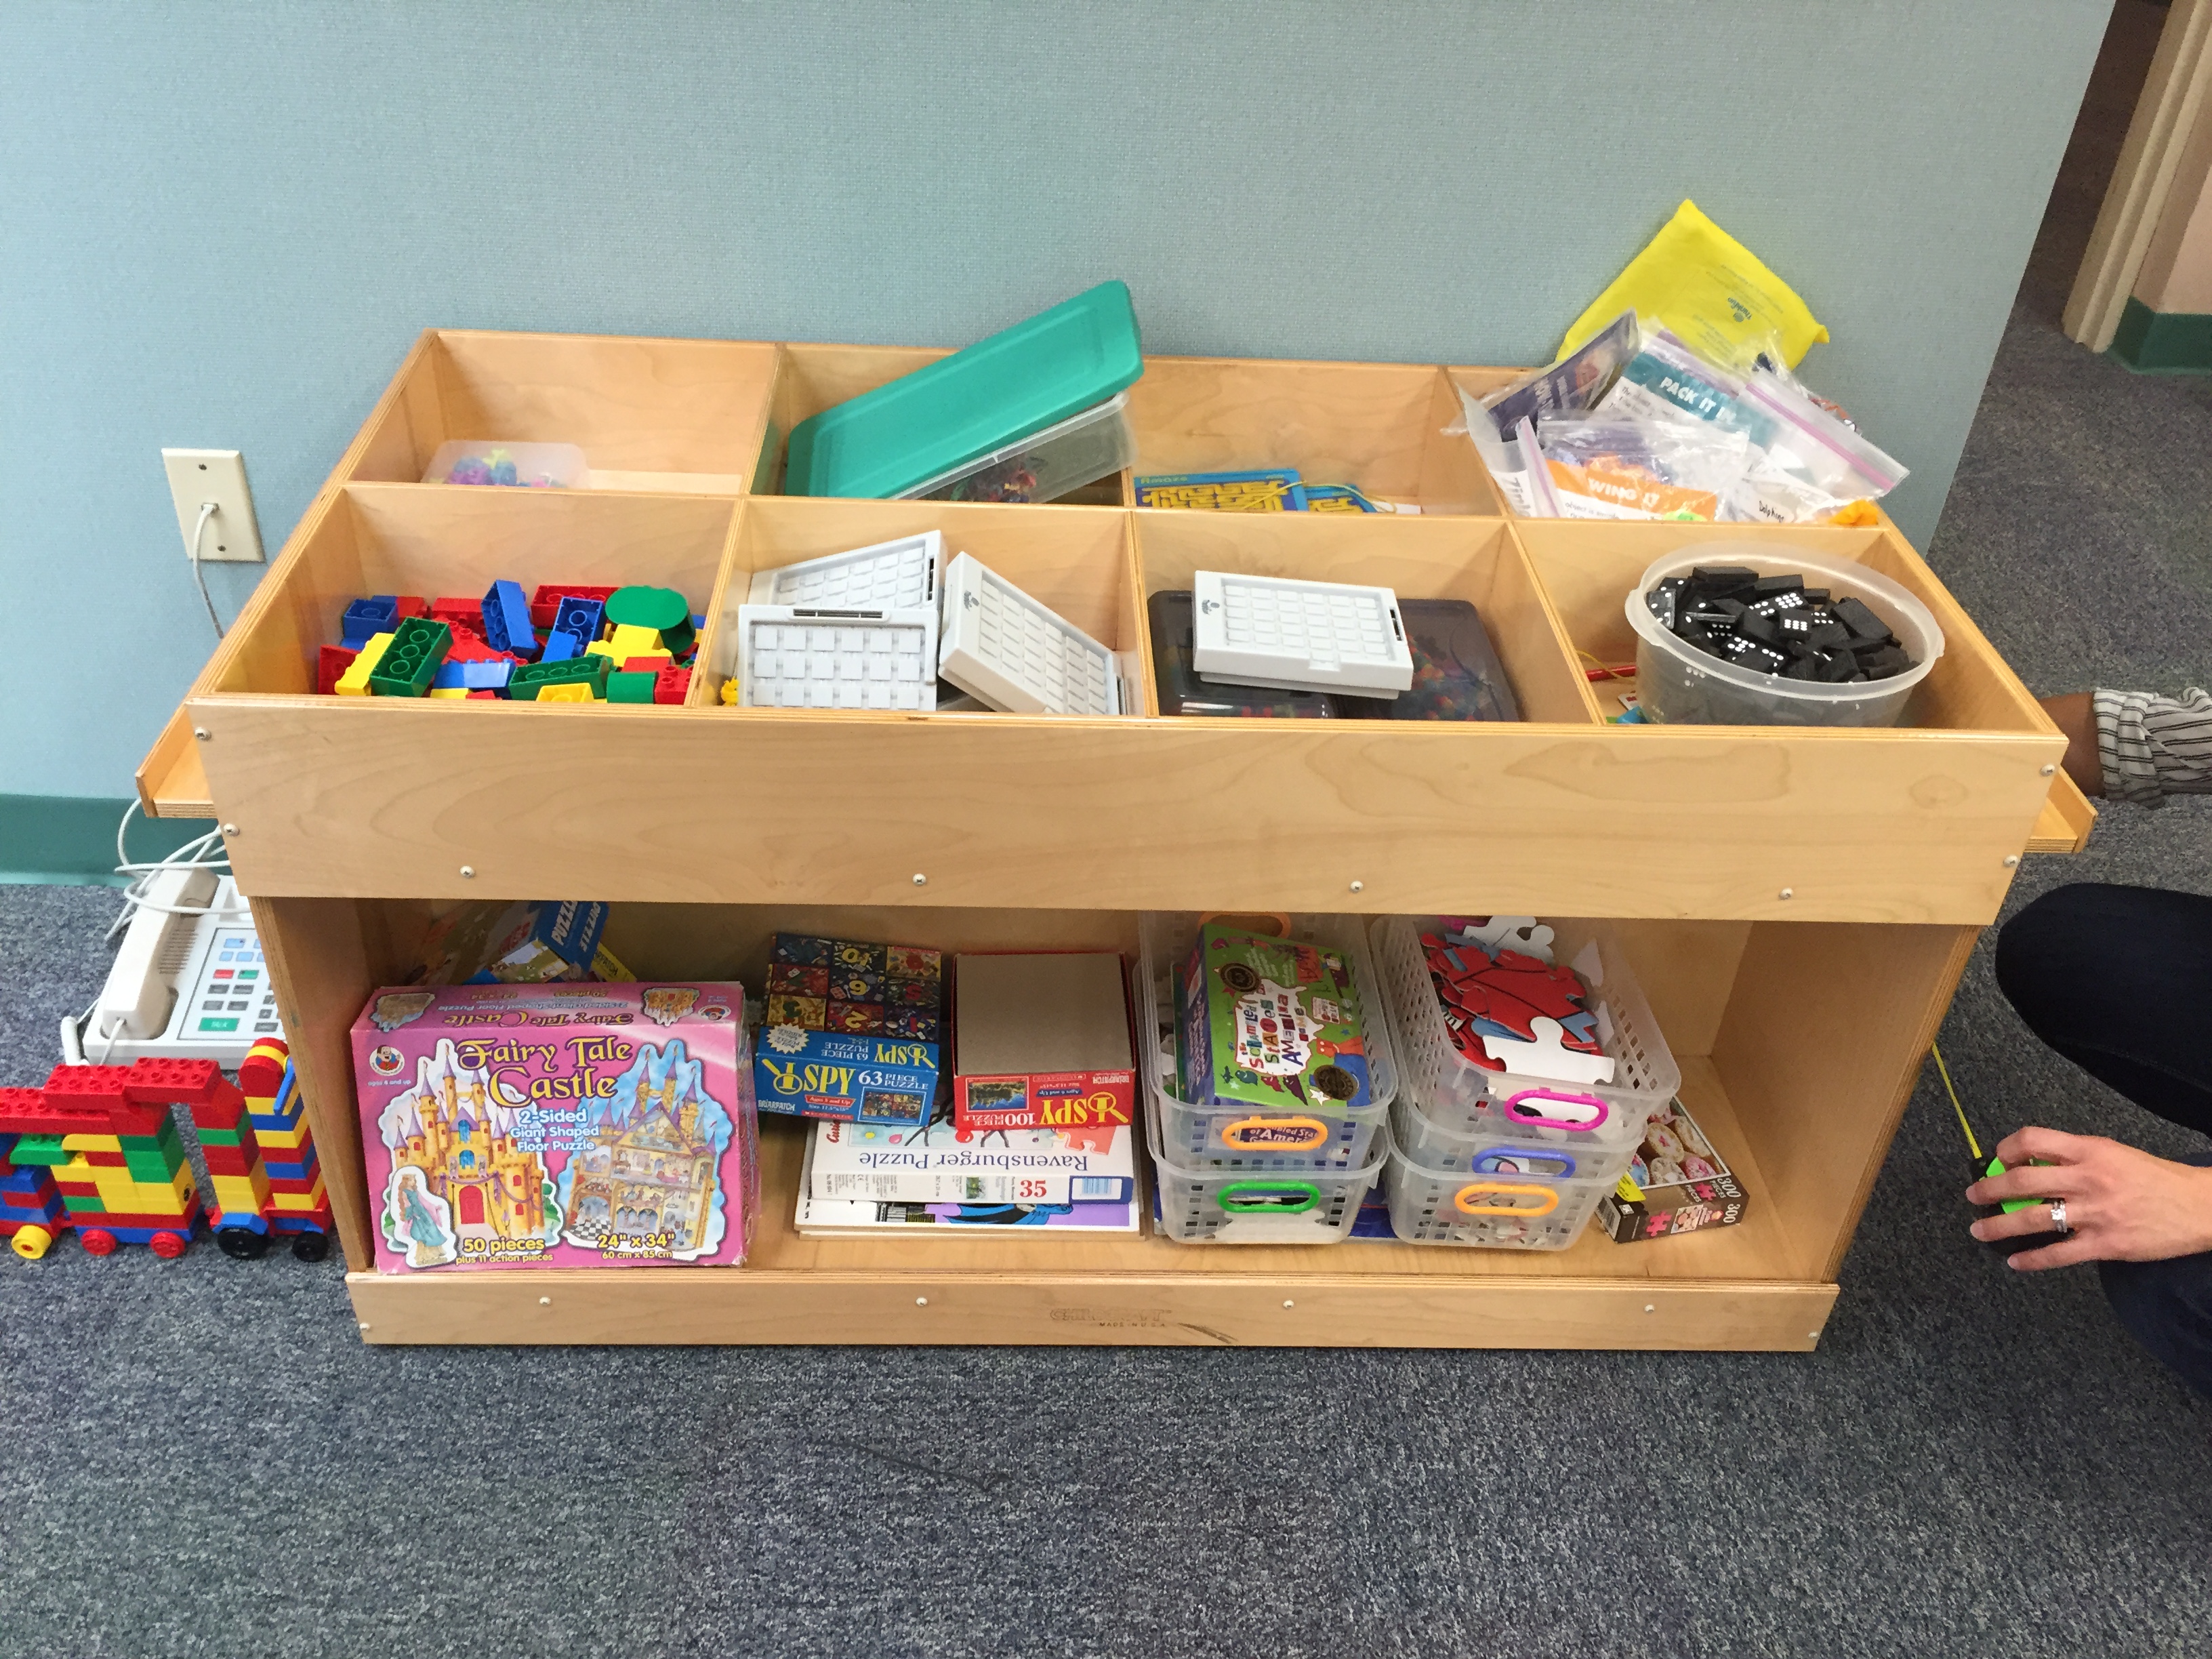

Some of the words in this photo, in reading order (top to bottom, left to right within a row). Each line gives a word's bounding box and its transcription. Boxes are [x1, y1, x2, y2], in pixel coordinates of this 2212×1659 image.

[1659, 376, 1699, 405] PACK
[1698, 397, 1718, 413] IT
[1587, 476, 1638, 501] WING
[442, 1010, 529, 1028] Castle
[529, 1013, 571, 1027] Tale
[572, 1012, 634, 1026] Fairy
[456, 1038, 558, 1073] Fairy
[565, 1036, 632, 1068] Tale
[821, 1048, 853, 1059] PIECE
[824, 1041, 869, 1052] PUZZLE
[874, 1043, 908, 1065] SPY
[856, 1052, 869, 1061] 63
[803, 1064, 857, 1095] SPY
[859, 1069, 883, 1086] 63
[885, 1073, 918, 1083] PIECE
[884, 1080, 928, 1090] PUZZLE
[488, 1065, 618, 1108] Castle
[519, 1108, 588, 1124] 2-Sided
[1004, 1113, 1036, 1126] 100
[1040, 1098, 1088, 1125] SPY
[974, 1118, 1004, 1126] PIECE
[510, 1127, 546, 1138] Giant
[548, 1125, 600, 1139] Shaped
[516, 1141, 549, 1152] Floor
[552, 1139, 596, 1151] Puzzle
[859, 1152, 928, 1170] Puzzle
[939, 1151, 1088, 1171] Ravensburger
[1019, 1179, 1047, 1198] 35
[1709, 1180, 1727, 1198] PIECES
[1717, 1177, 1742, 1198] 300
[1723, 1203, 1741, 1223] 300
[463, 1240, 486, 1252] 50
[489, 1237, 546, 1254] pieces
[596, 1234, 628, 1248] 24"
[630, 1237, 641, 1247] x
[643, 1233, 676, 1248] 34"
[455, 1254, 476, 1266] plus
[478, 1254, 486, 1263] 11
[489, 1254, 520, 1264] action
[522, 1253, 554, 1264] pieces
[602, 1251, 615, 1260] 60
[617, 1252, 633, 1260] cm
[642, 1250, 656, 1258] 85
